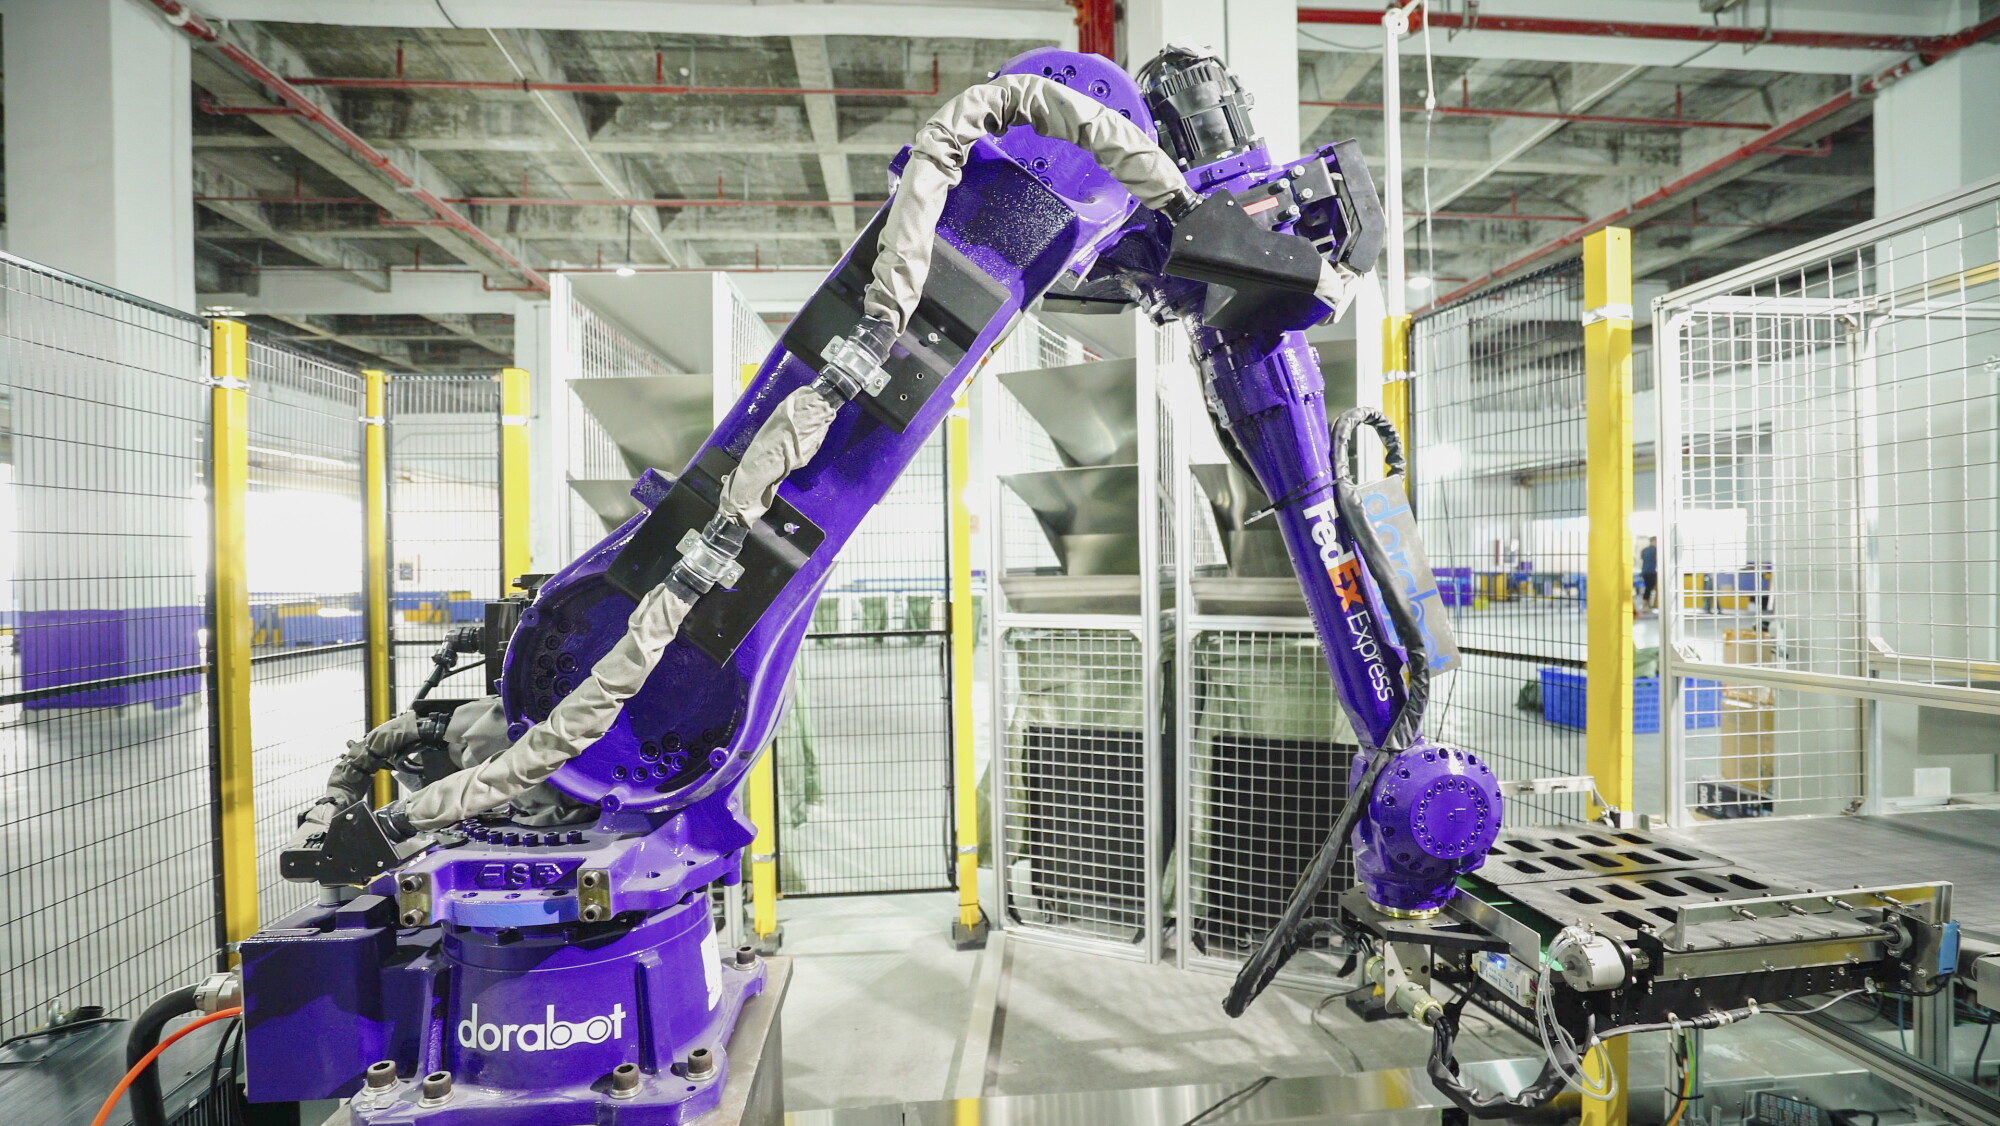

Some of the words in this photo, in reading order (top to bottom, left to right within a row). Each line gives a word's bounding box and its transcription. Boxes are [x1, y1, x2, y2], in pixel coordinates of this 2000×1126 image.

[1303, 498, 1365, 613] FedEx
[1346, 610, 1394, 702] Express
[457, 1002, 627, 1052] dorabot
